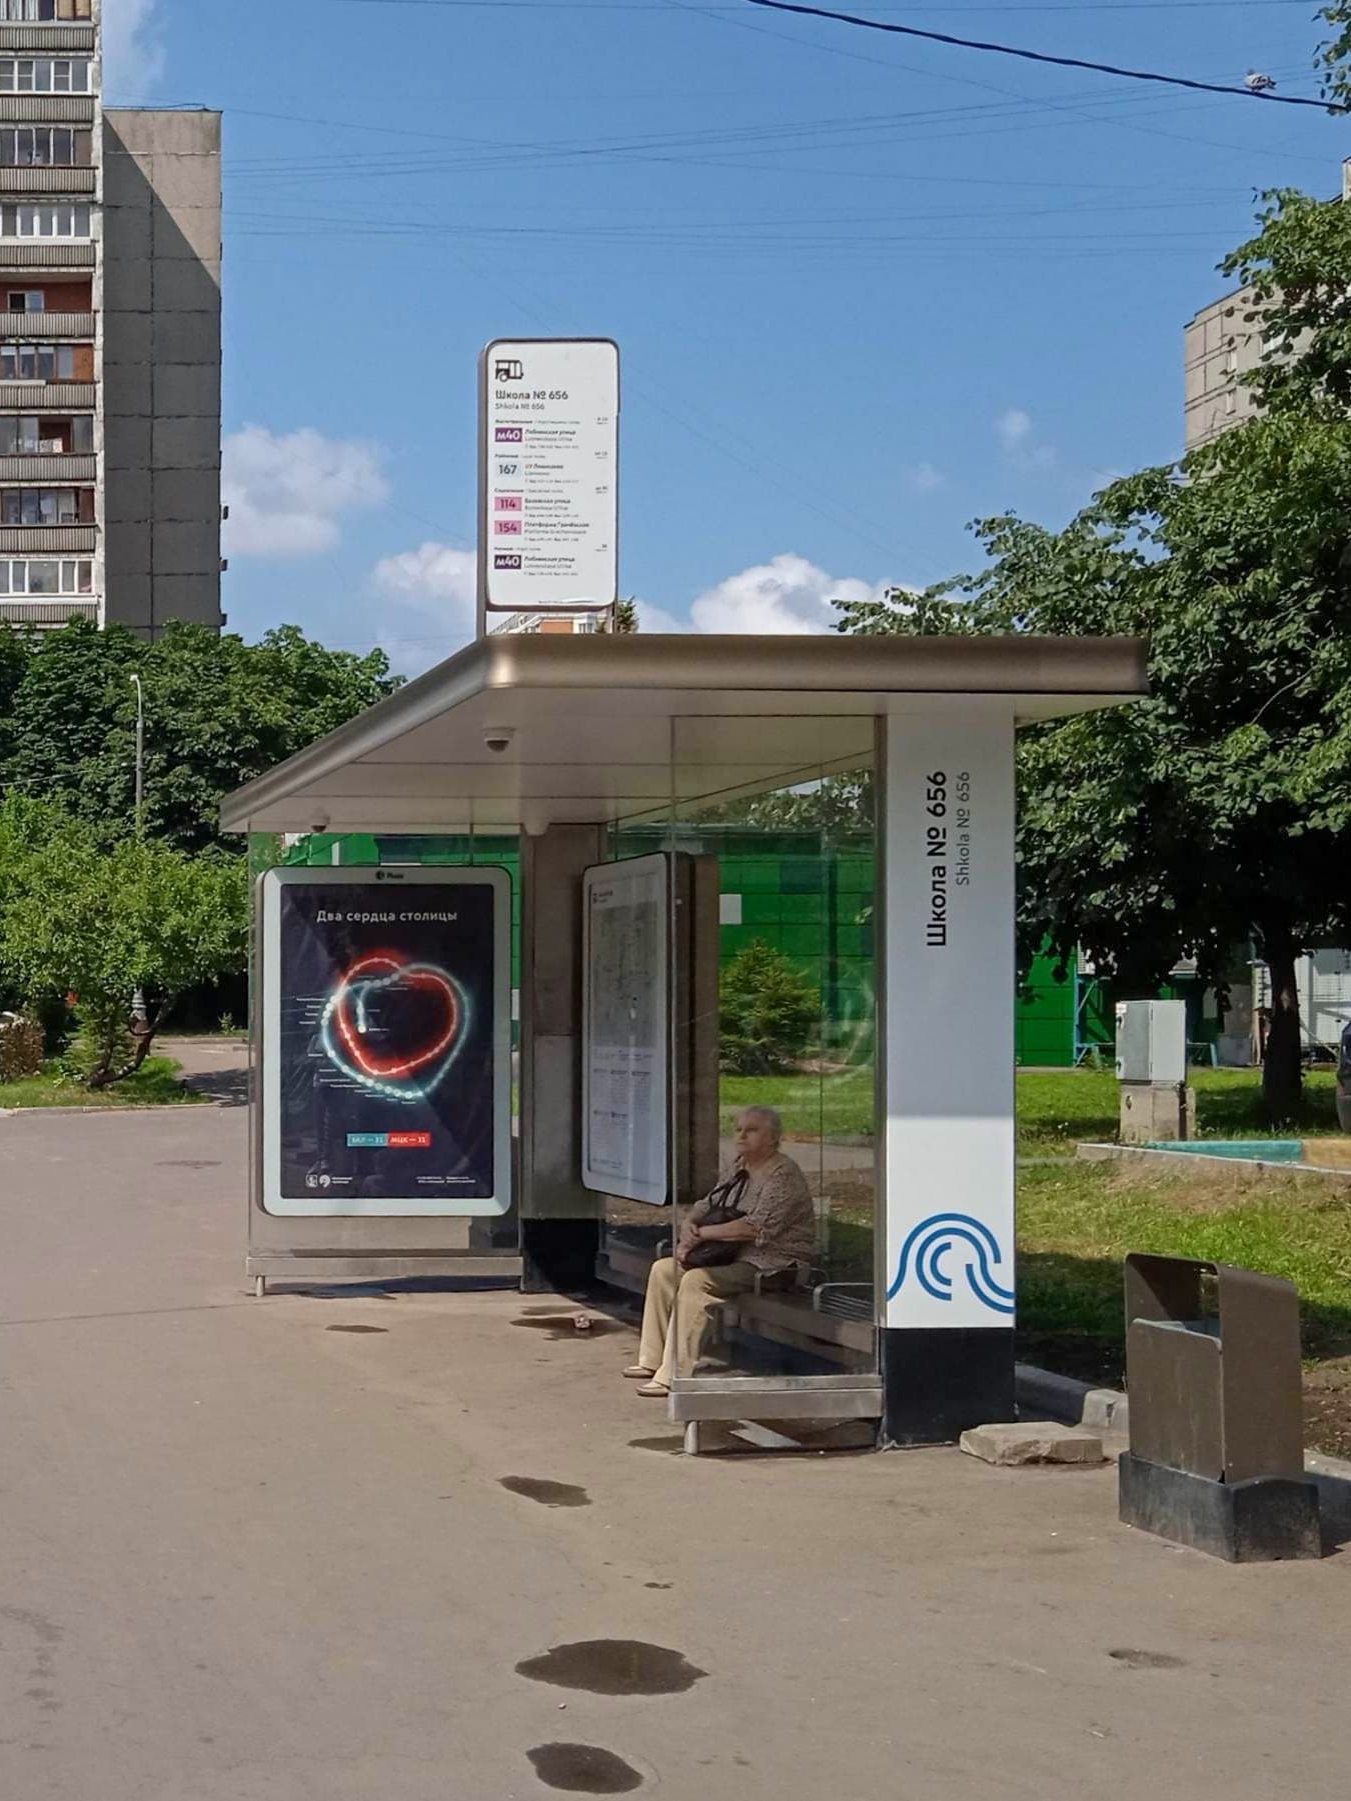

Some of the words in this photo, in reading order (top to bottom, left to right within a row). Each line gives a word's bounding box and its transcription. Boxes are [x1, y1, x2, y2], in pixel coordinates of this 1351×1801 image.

[495, 390, 530, 400] Школа
[533, 390, 546, 400] №
[548, 390, 568, 400] 656
[496, 431, 521, 440] м40
[499, 464, 517, 475] 167
[500, 499, 516, 509] 114
[499, 522, 517, 533] 154
[496, 556, 520, 566] м40
[956, 771, 970, 802] 656
[926, 771, 947, 818] 656
[956, 808, 970, 829] №
[926, 826, 947, 857] №
[955, 832, 970, 886] Shkola
[926, 865, 947, 947] Школа
[316, 910, 342, 923] Два
[346, 912, 396, 924] сердца
[399, 911, 458, 922] столицы
